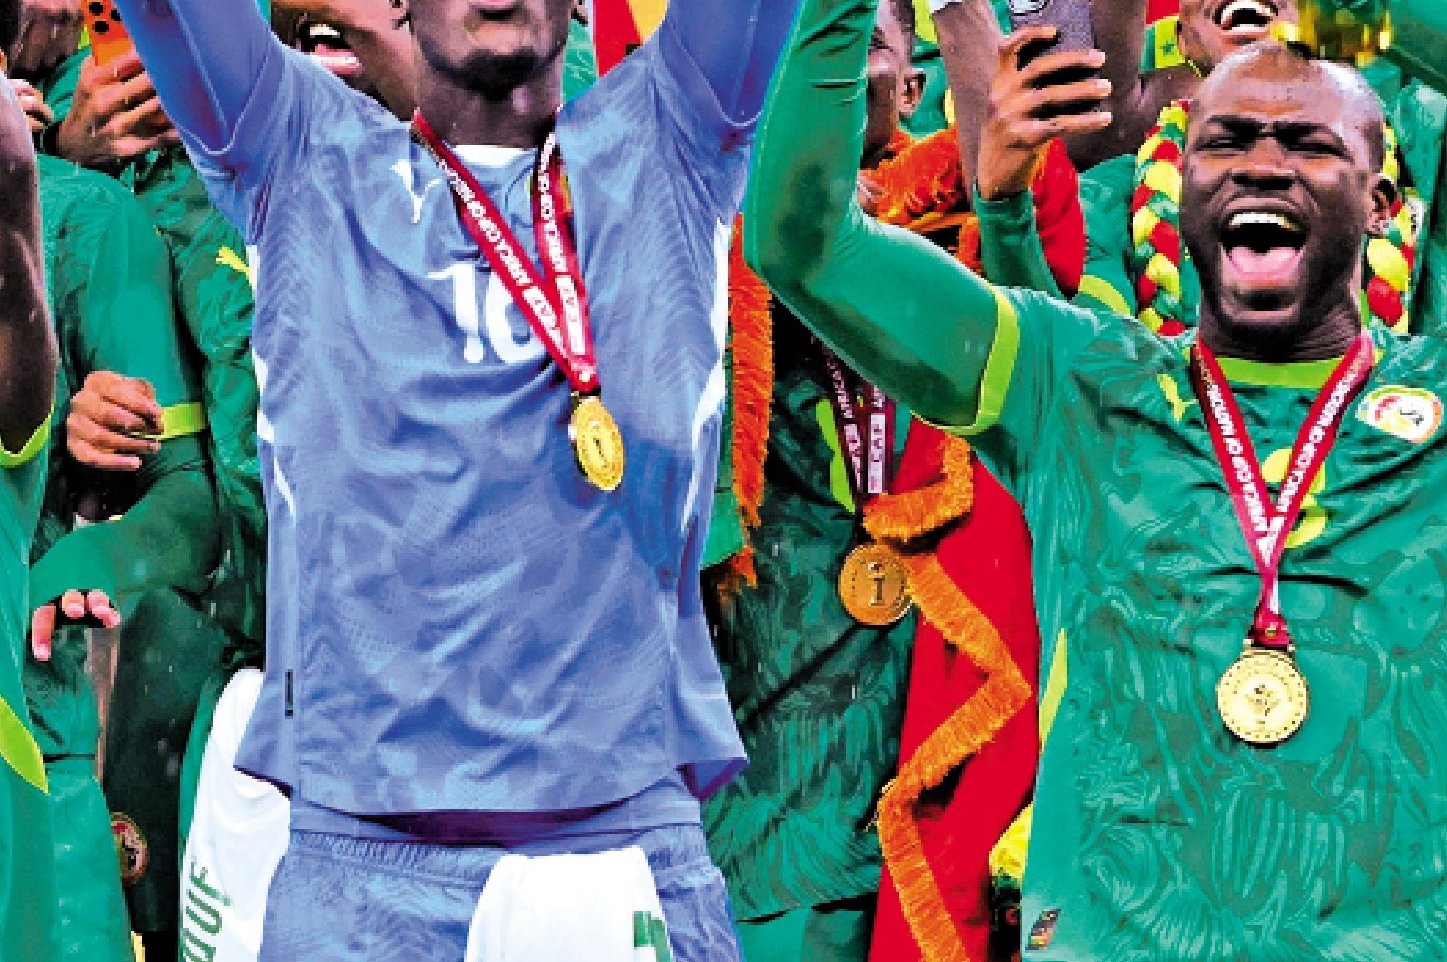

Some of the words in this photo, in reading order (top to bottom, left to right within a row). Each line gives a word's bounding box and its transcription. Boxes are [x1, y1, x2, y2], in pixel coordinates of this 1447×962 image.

[466, 200, 487, 220] OF
[477, 219, 502, 244] CUP
[544, 219, 568, 273] AFRICA
[493, 238, 533, 286] AFRICA
[1223, 437, 1244, 456] OF
[1231, 456, 1252, 483] CUP
[1275, 469, 1305, 513] AFRICA
[1296, 442, 1318, 470] CUP
[1308, 425, 1327, 444] OF
